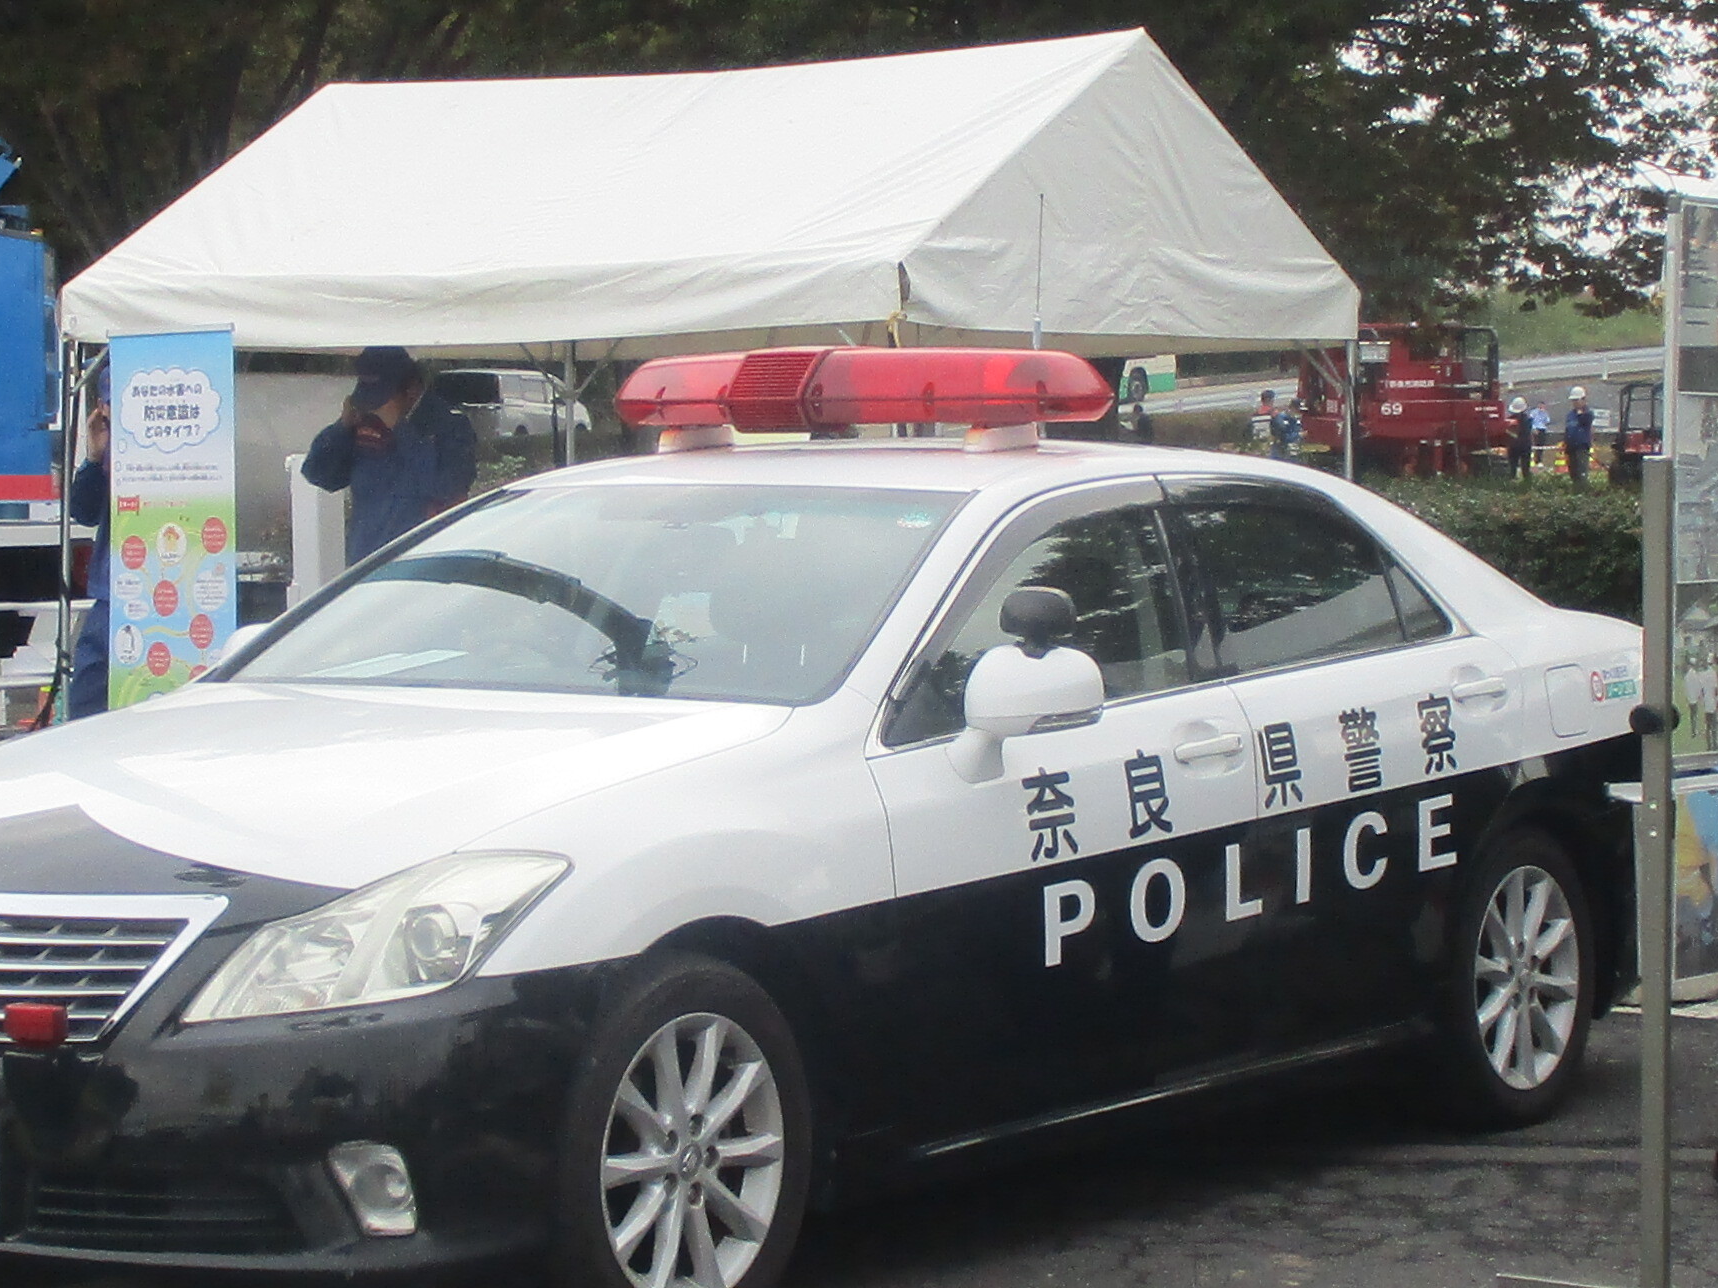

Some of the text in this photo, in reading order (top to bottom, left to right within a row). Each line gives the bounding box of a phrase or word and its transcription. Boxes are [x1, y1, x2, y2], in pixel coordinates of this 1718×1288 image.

[1380, 402, 1403, 416] 69
[1021, 692, 1458, 863] 奈良県警察
[1043, 792, 1459, 968] POLICE
